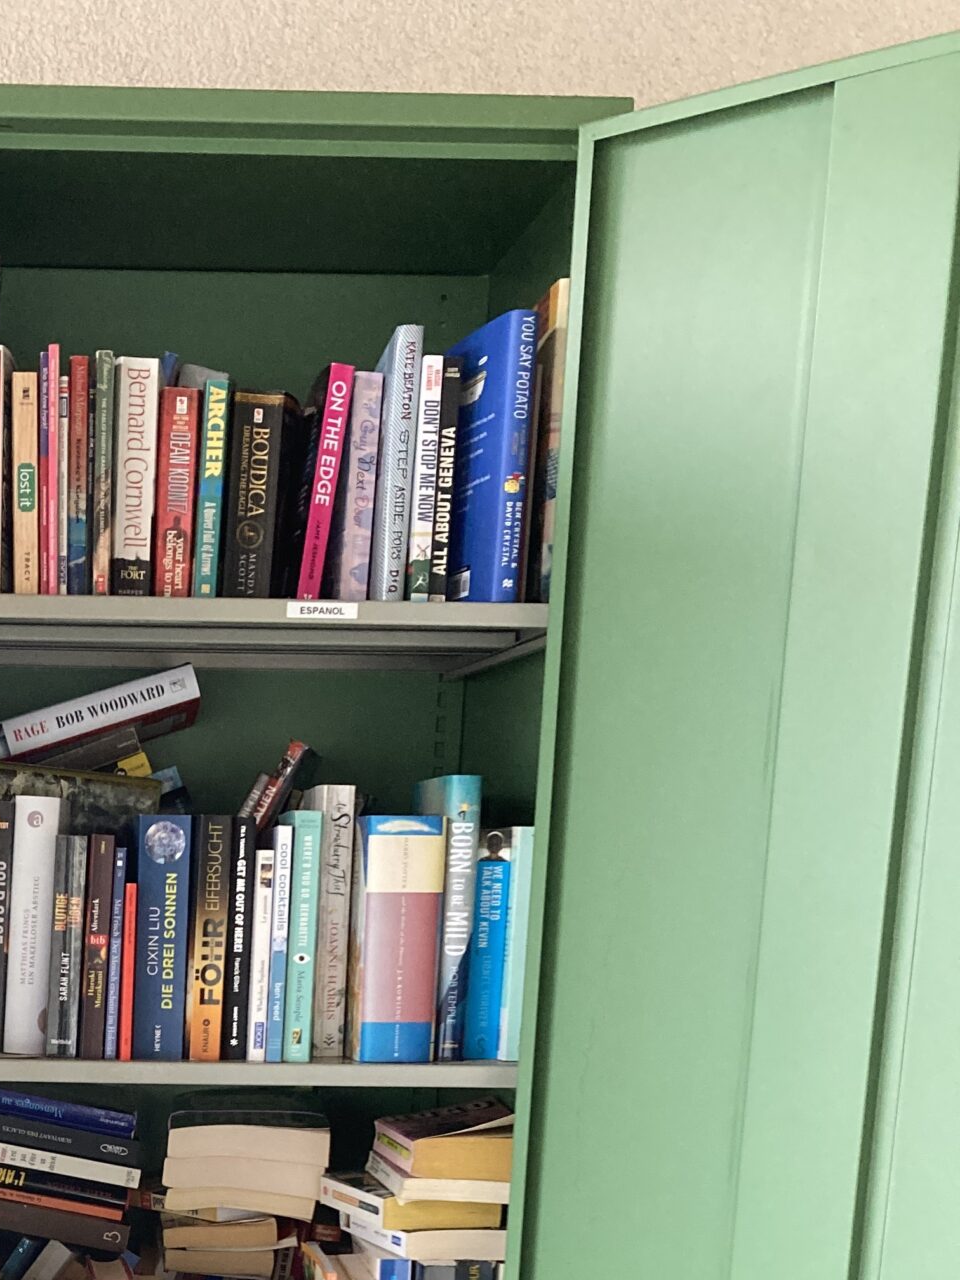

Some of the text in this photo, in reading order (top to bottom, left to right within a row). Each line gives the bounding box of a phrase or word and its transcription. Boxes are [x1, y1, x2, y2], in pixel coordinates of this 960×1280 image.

[401, 341, 417, 420] KATE BEATON
[513, 316, 536, 419] YOU SAY POTATO
[124, 368, 151, 547] Bernard Cornwell
[167, 432, 191, 513] DEAN KOONTZ
[205, 386, 225, 478] ARCHER
[247, 427, 269, 517] BOUDICA
[315, 381, 347, 506] ON THE EDGE
[417, 400, 440, 523] DON'T STOP ME NOW
[20, 468, 34, 507] lost it
[432, 427, 457, 575] ALL ABOUT GENEVA
[12, 682, 165, 742] RAGE BOB WOODWARD
[205, 822, 223, 910] EIFERSUCHT
[233, 860, 247, 952] GET ME OUT OF HERE!
[276, 843, 289, 931] cool cocktails
[445, 822, 475, 956] BORN TO BE MILD
[147, 907, 160, 975] CIXIN LIU
[161, 873, 178, 1009] DIE DREI SONNEN
[195, 918, 224, 1006] FÖHR
